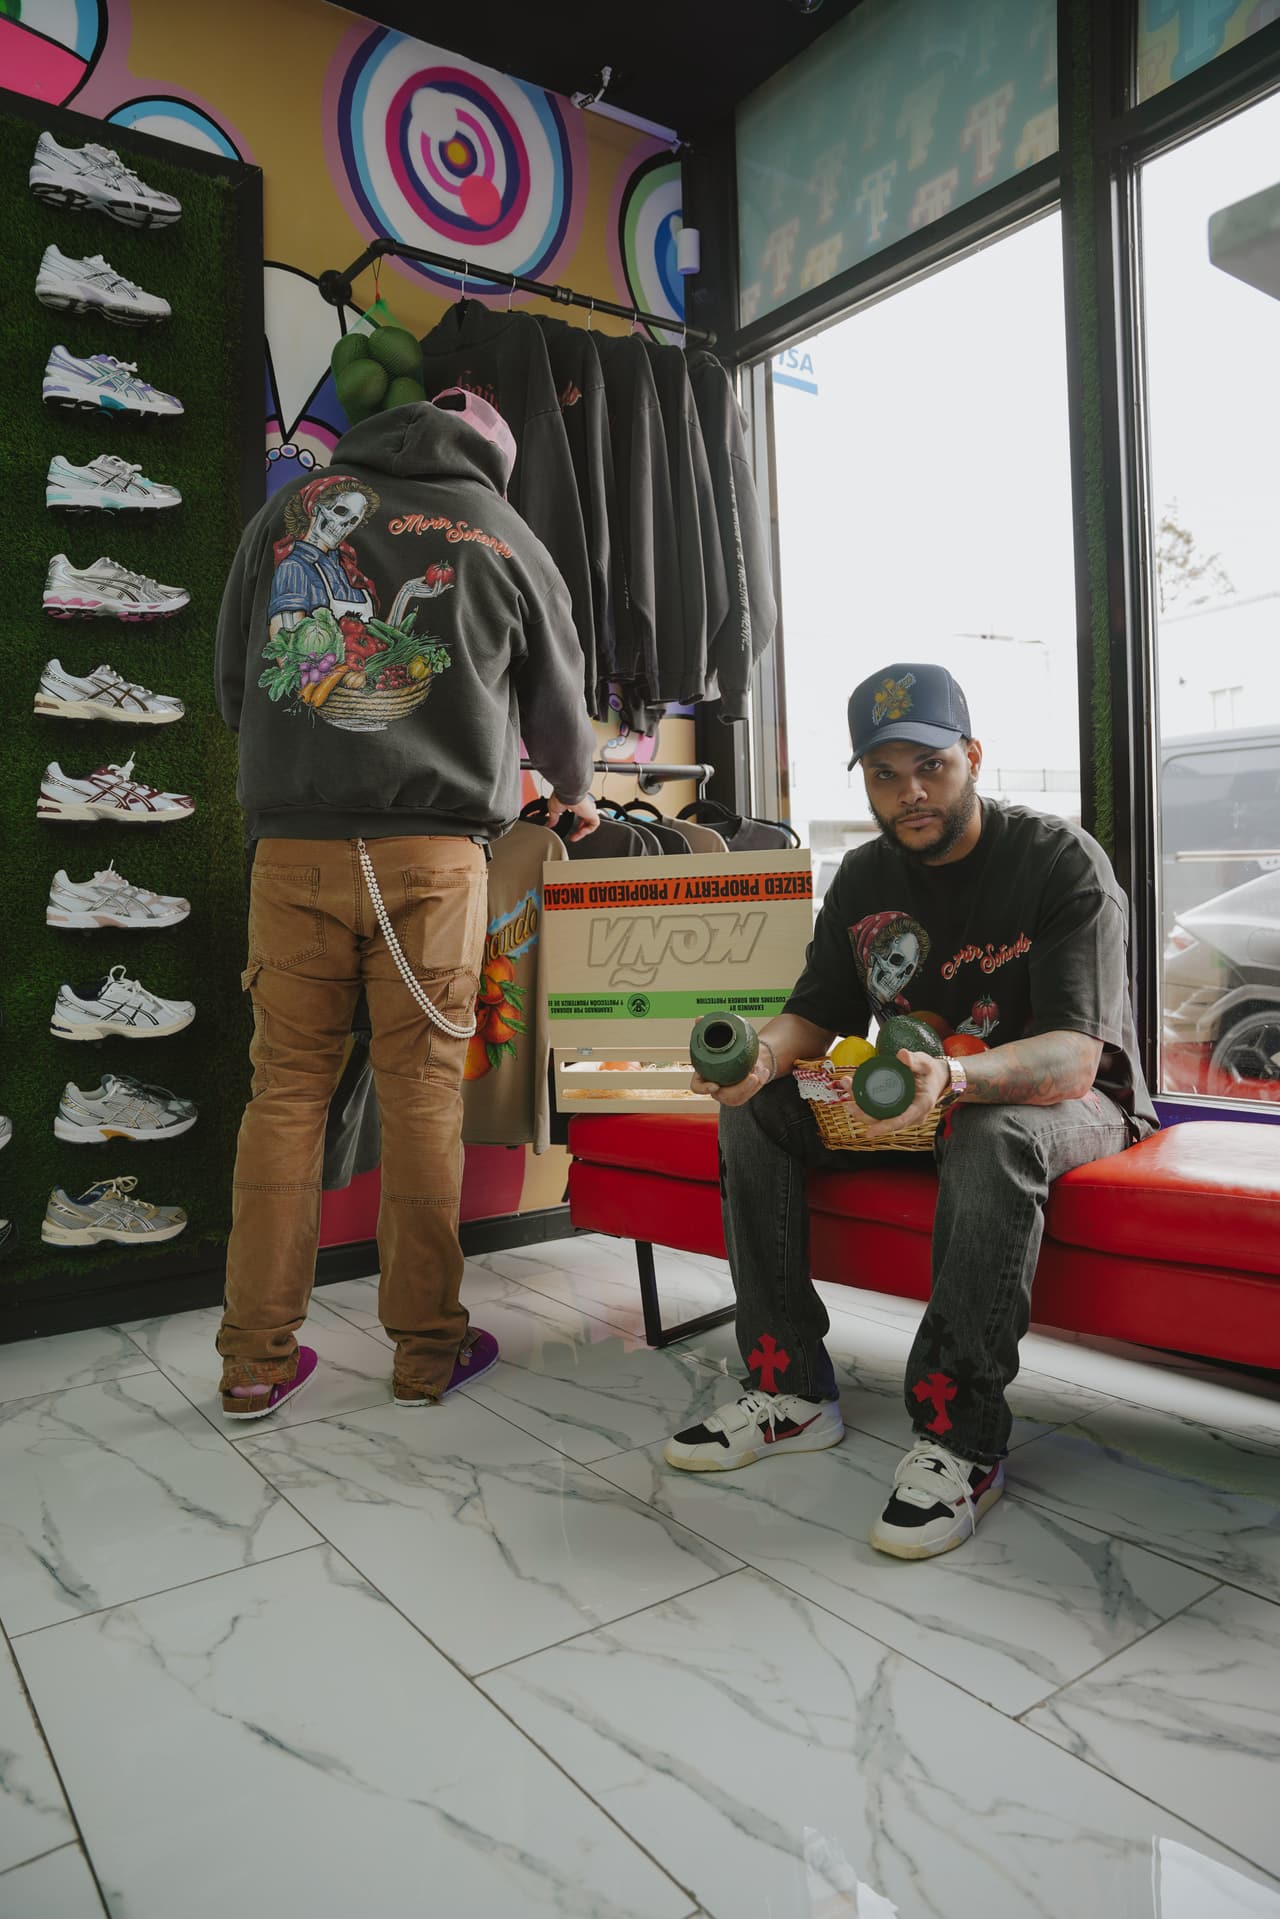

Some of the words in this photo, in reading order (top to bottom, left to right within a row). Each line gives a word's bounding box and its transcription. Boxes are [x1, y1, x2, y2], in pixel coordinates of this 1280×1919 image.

[778, 346, 814, 374] ISA
[589, 883, 668, 903] PROPIEDAD
[674, 883, 681, 899] /
[685, 878, 760, 899] PROPERTY
[765, 877, 813, 894] SEIZED
[544, 888, 585, 905] INCAU
[696, 997, 727, 1005] PROTECTION
